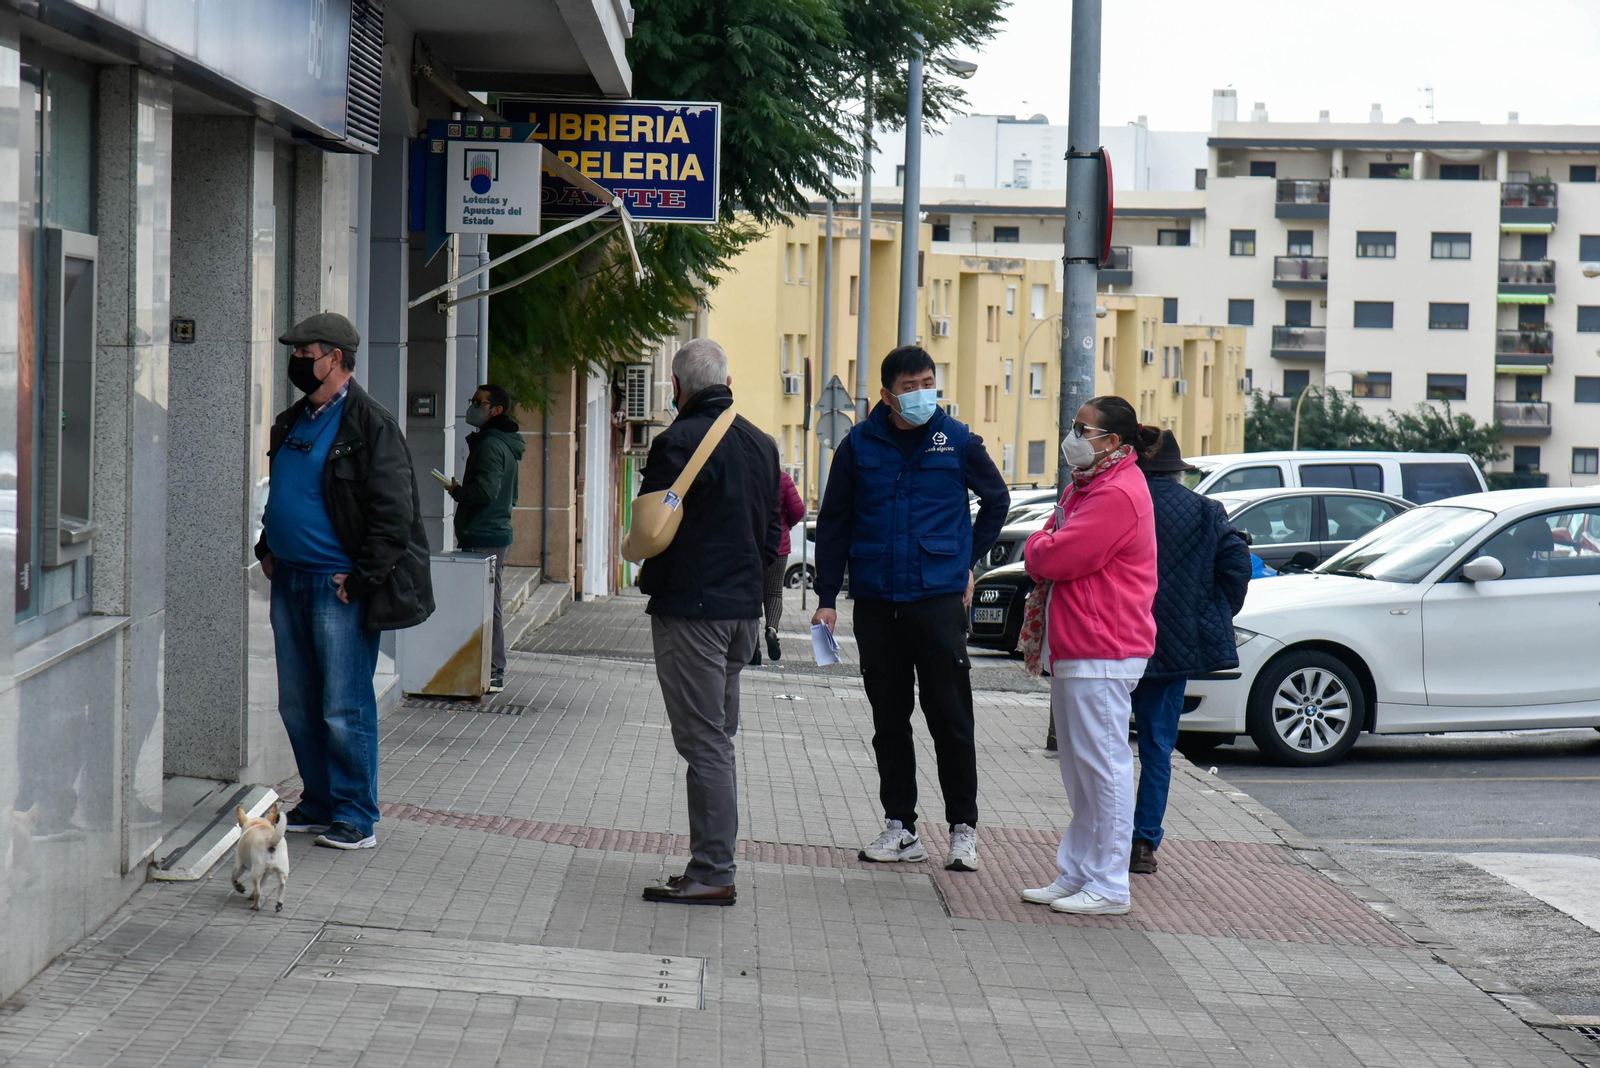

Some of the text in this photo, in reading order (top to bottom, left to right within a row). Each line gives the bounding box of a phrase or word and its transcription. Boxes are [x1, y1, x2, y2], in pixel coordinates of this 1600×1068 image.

[529, 112, 690, 143] LIBRERIA
[542, 150, 705, 181] PELERIA
[463, 195, 508, 206] Loterías y
[463, 206, 522, 216] Apuestas del
[462, 216, 494, 225] Estado
